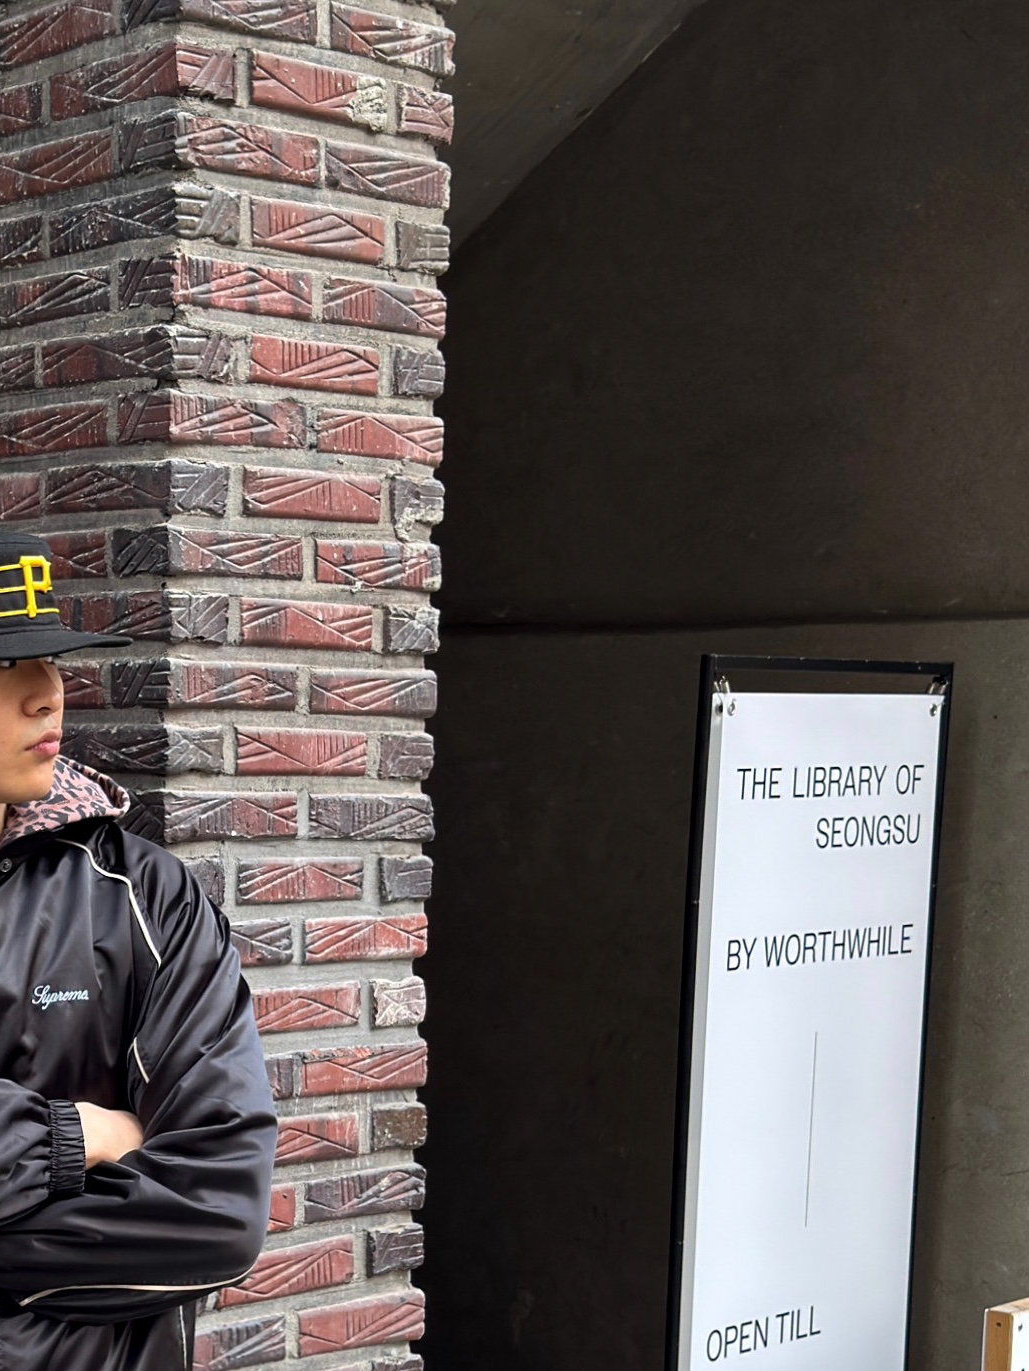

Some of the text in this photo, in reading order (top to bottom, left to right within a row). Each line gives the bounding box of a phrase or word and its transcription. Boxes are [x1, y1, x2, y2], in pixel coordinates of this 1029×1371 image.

[17, 556, 53, 618] P
[737, 765, 925, 800] THE LIBRARY OF
[816, 814, 921, 849] SEONGSU
[727, 923, 914, 972] BY WORTHWHILE
[706, 1306, 821, 1362] OPEN TILL
